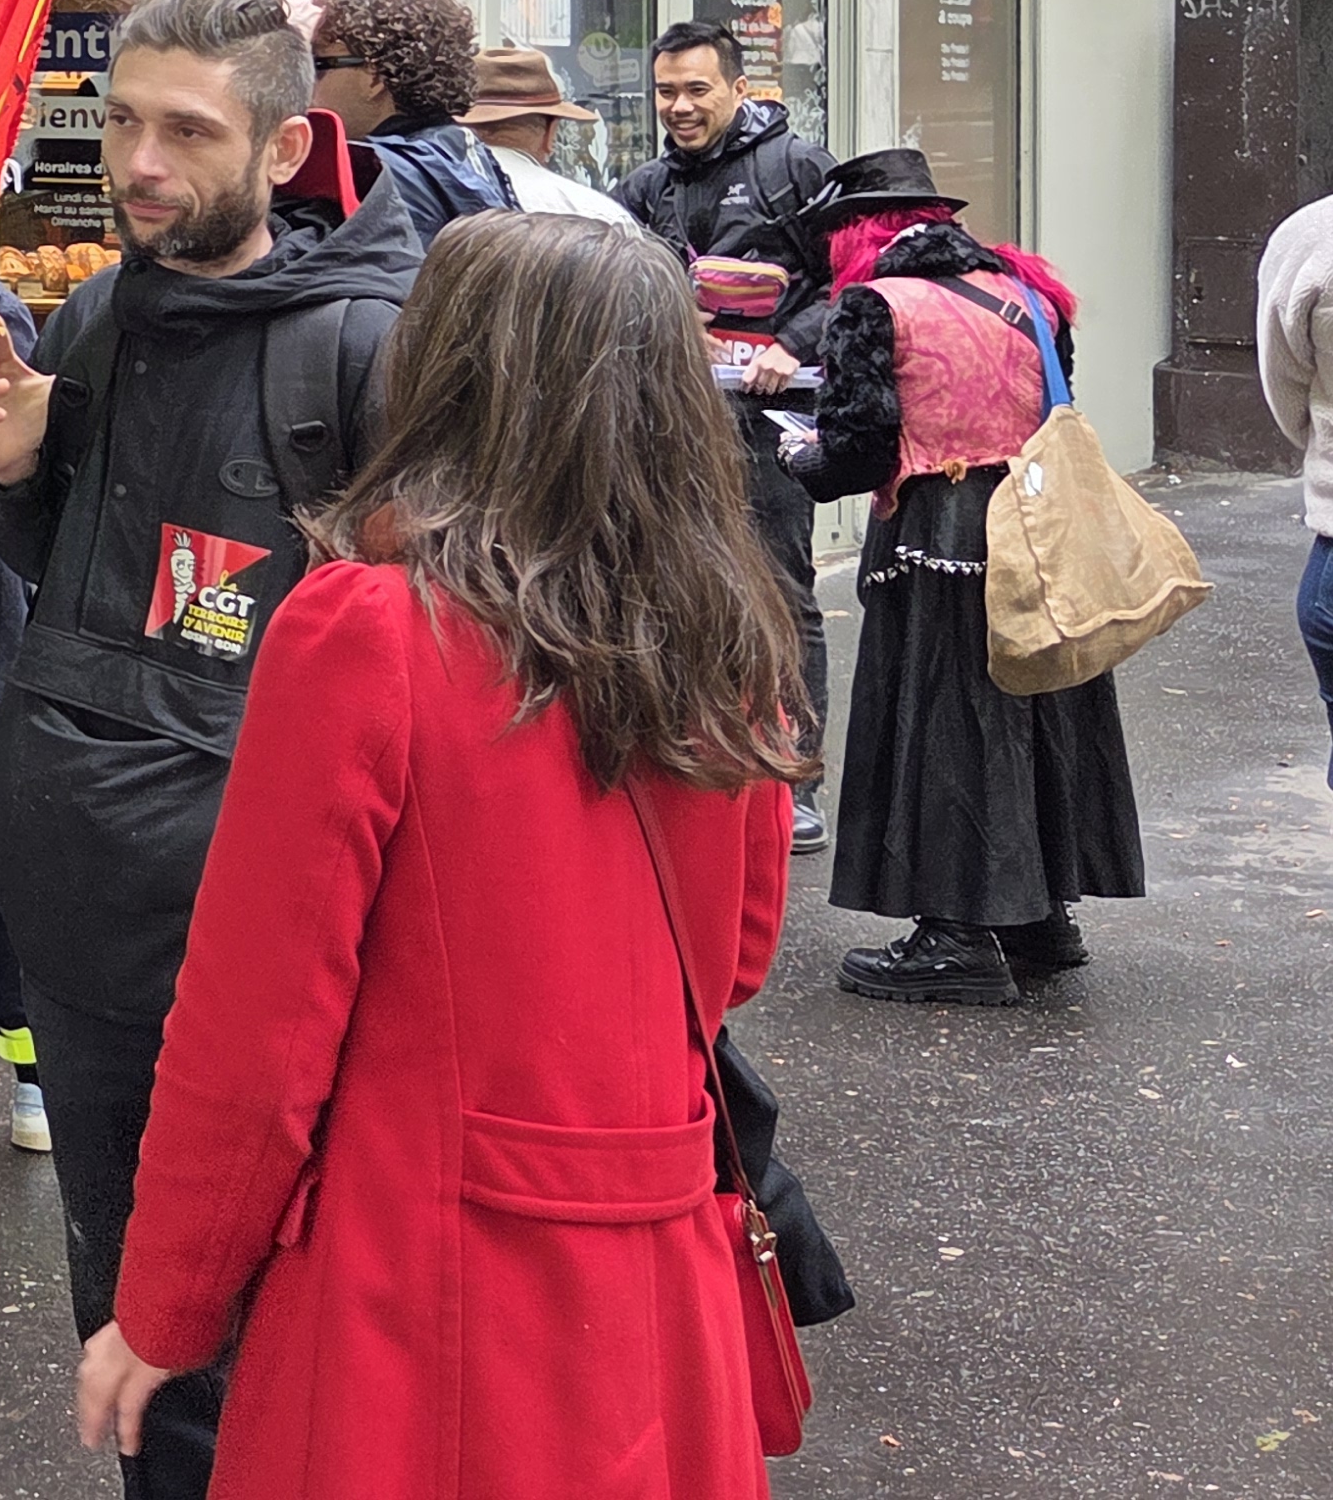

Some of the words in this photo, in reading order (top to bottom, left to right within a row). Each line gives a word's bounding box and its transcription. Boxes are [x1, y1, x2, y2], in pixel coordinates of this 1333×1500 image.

[35, 161, 91, 174] Horaires
[51, 216, 101, 228] Dimanche
[198, 586, 255, 617] CGT
[182, 615, 245, 644] D'AVENIR
[188, 603, 248, 630] TERROIRS
